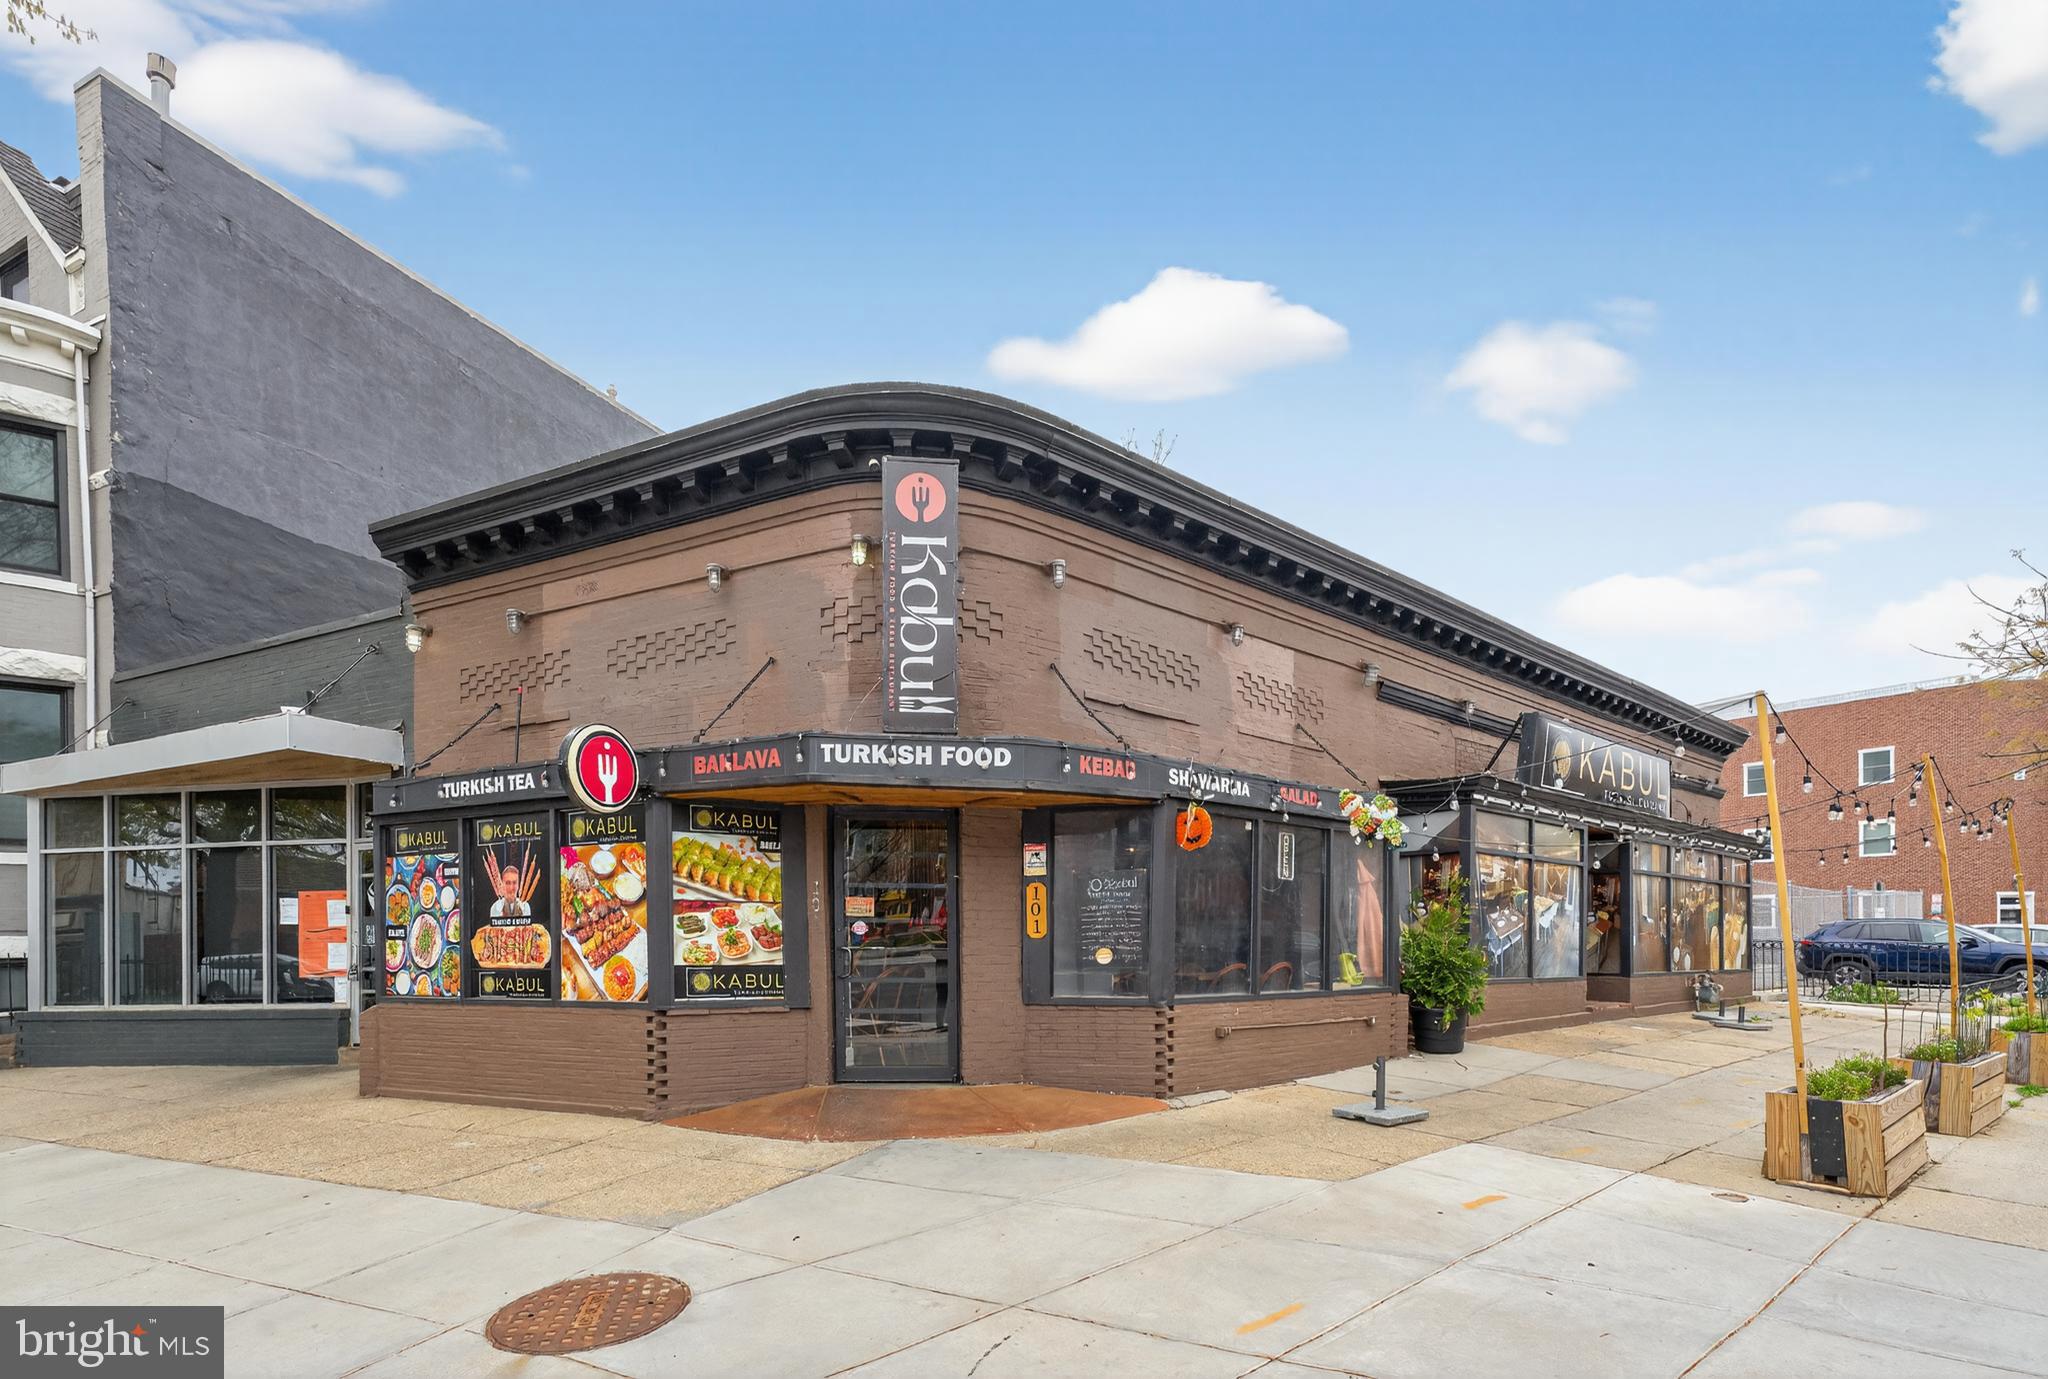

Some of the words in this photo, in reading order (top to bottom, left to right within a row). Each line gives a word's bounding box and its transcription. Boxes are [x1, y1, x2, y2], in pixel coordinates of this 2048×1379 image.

[693, 747, 781, 775] BAKLAVA
[820, 743, 933, 767] TURKISH
[940, 746, 1012, 767] FOOD
[1579, 737, 1668, 800] KABUL
[443, 776, 505, 799] TURKISH
[507, 772, 536, 792] TEA
[1168, 767, 1251, 798] SHAWARMA
[493, 821, 543, 838] KABUL
[585, 815, 638, 836] KABUL
[713, 811, 779, 830] KABUL
[408, 830, 449, 847] KABUL
[1030, 886, 1041, 934] 101
[495, 977, 545, 993] KABUL
[713, 973, 784, 989] KABUL
